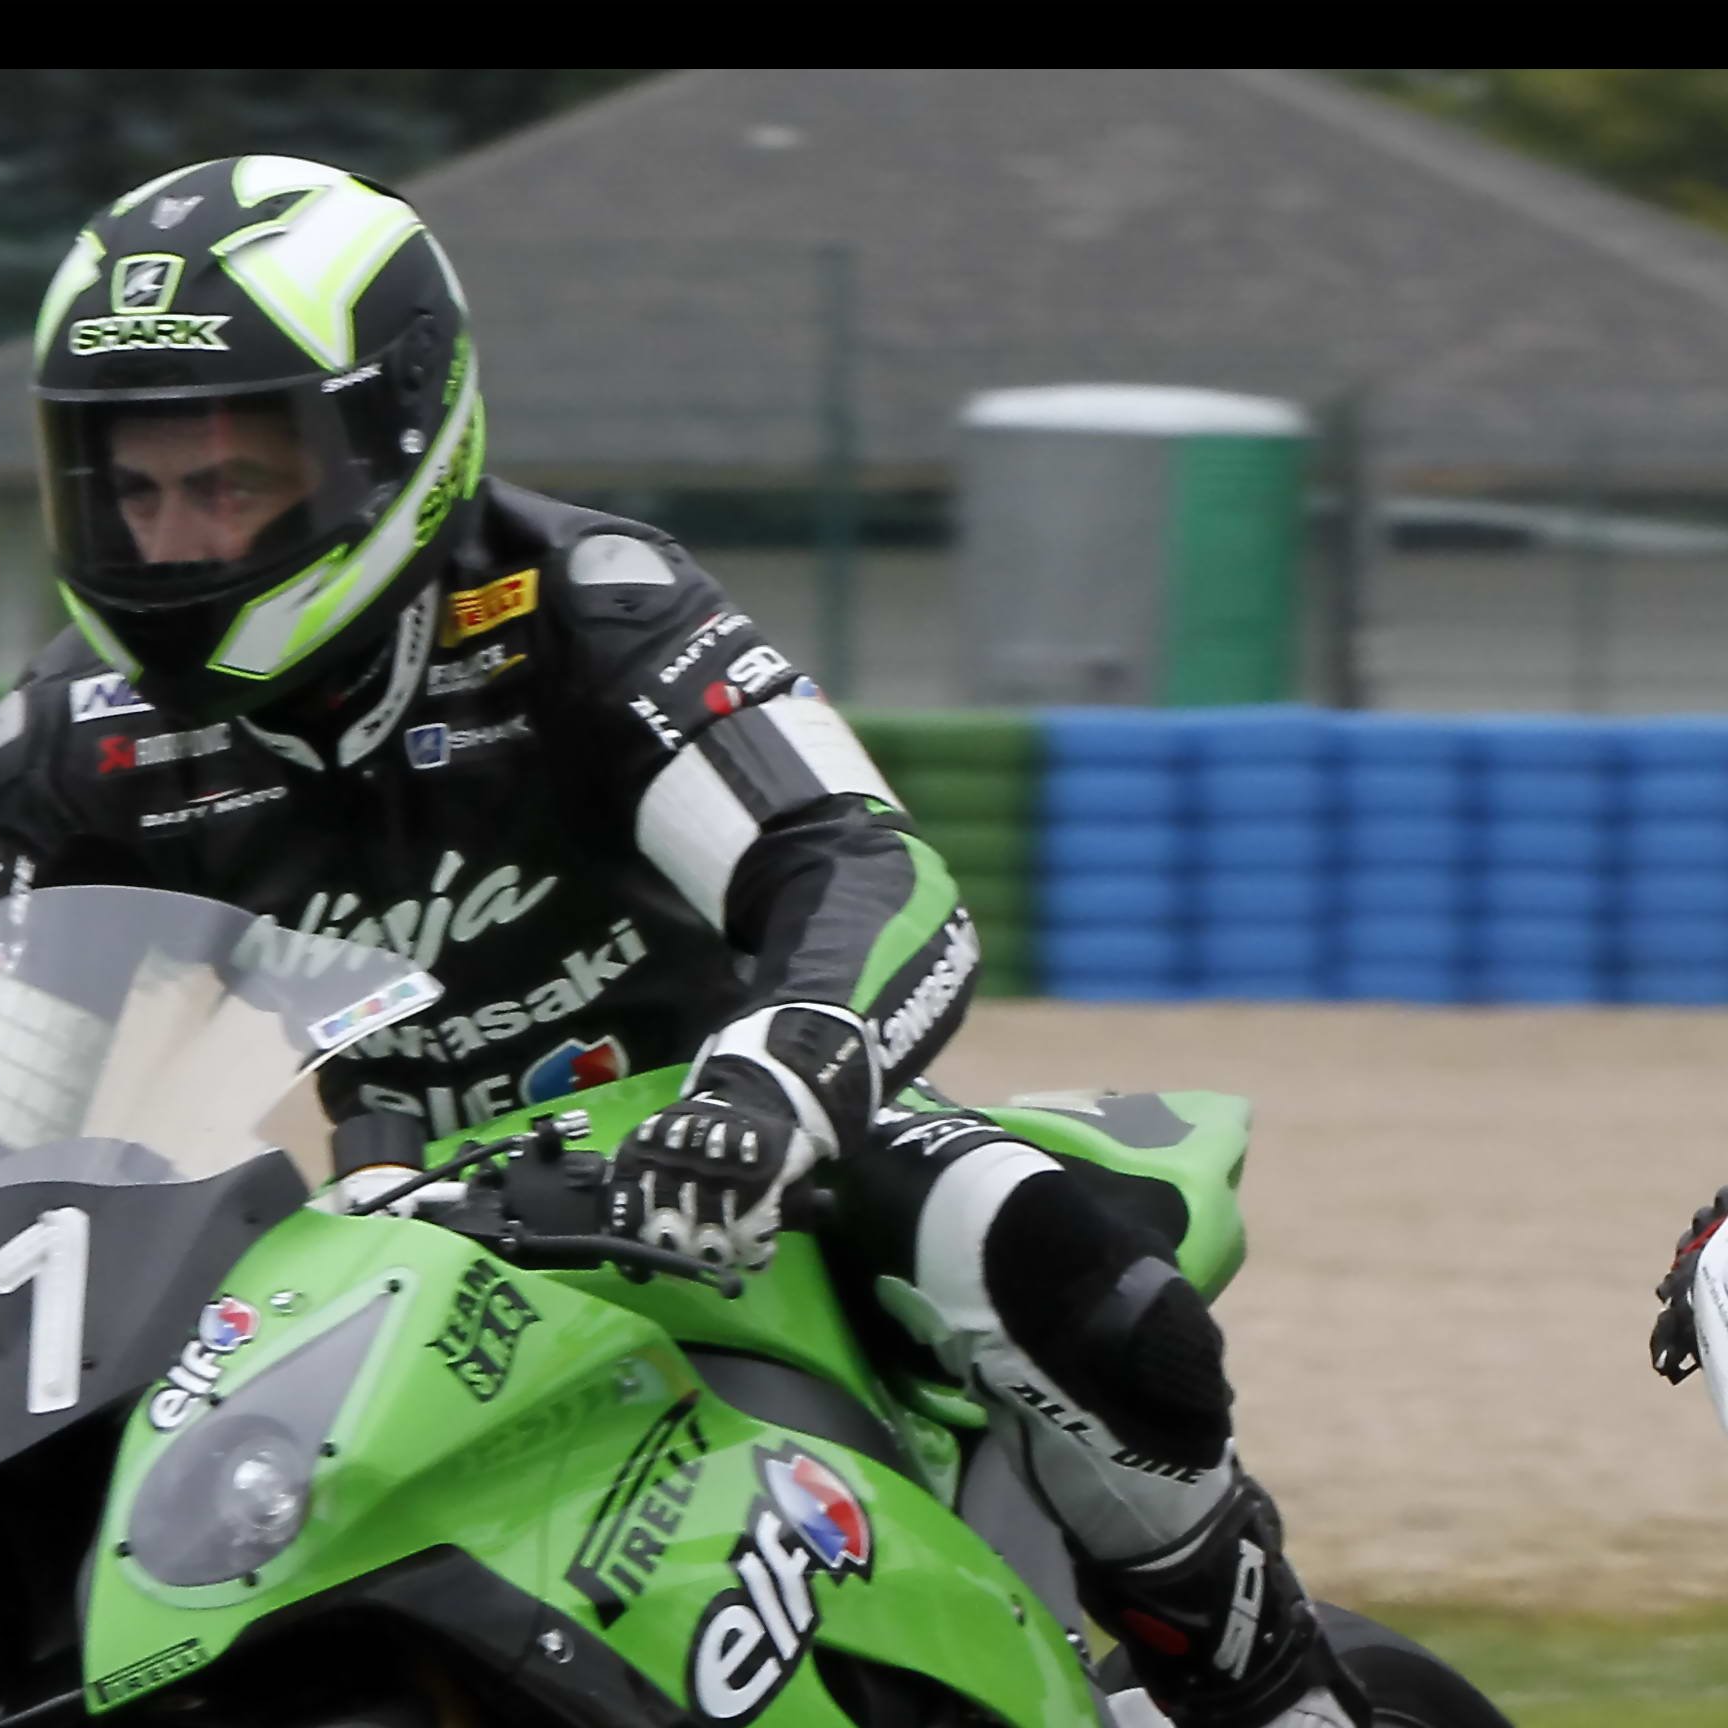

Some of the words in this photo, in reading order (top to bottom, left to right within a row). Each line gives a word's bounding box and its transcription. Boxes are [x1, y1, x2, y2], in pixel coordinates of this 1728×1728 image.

[71, 314, 232, 354] SHARK
[149, 1338, 228, 1431] elf
[564, 1390, 710, 1629] PIRELLI
[694, 1510, 815, 1720] elf
